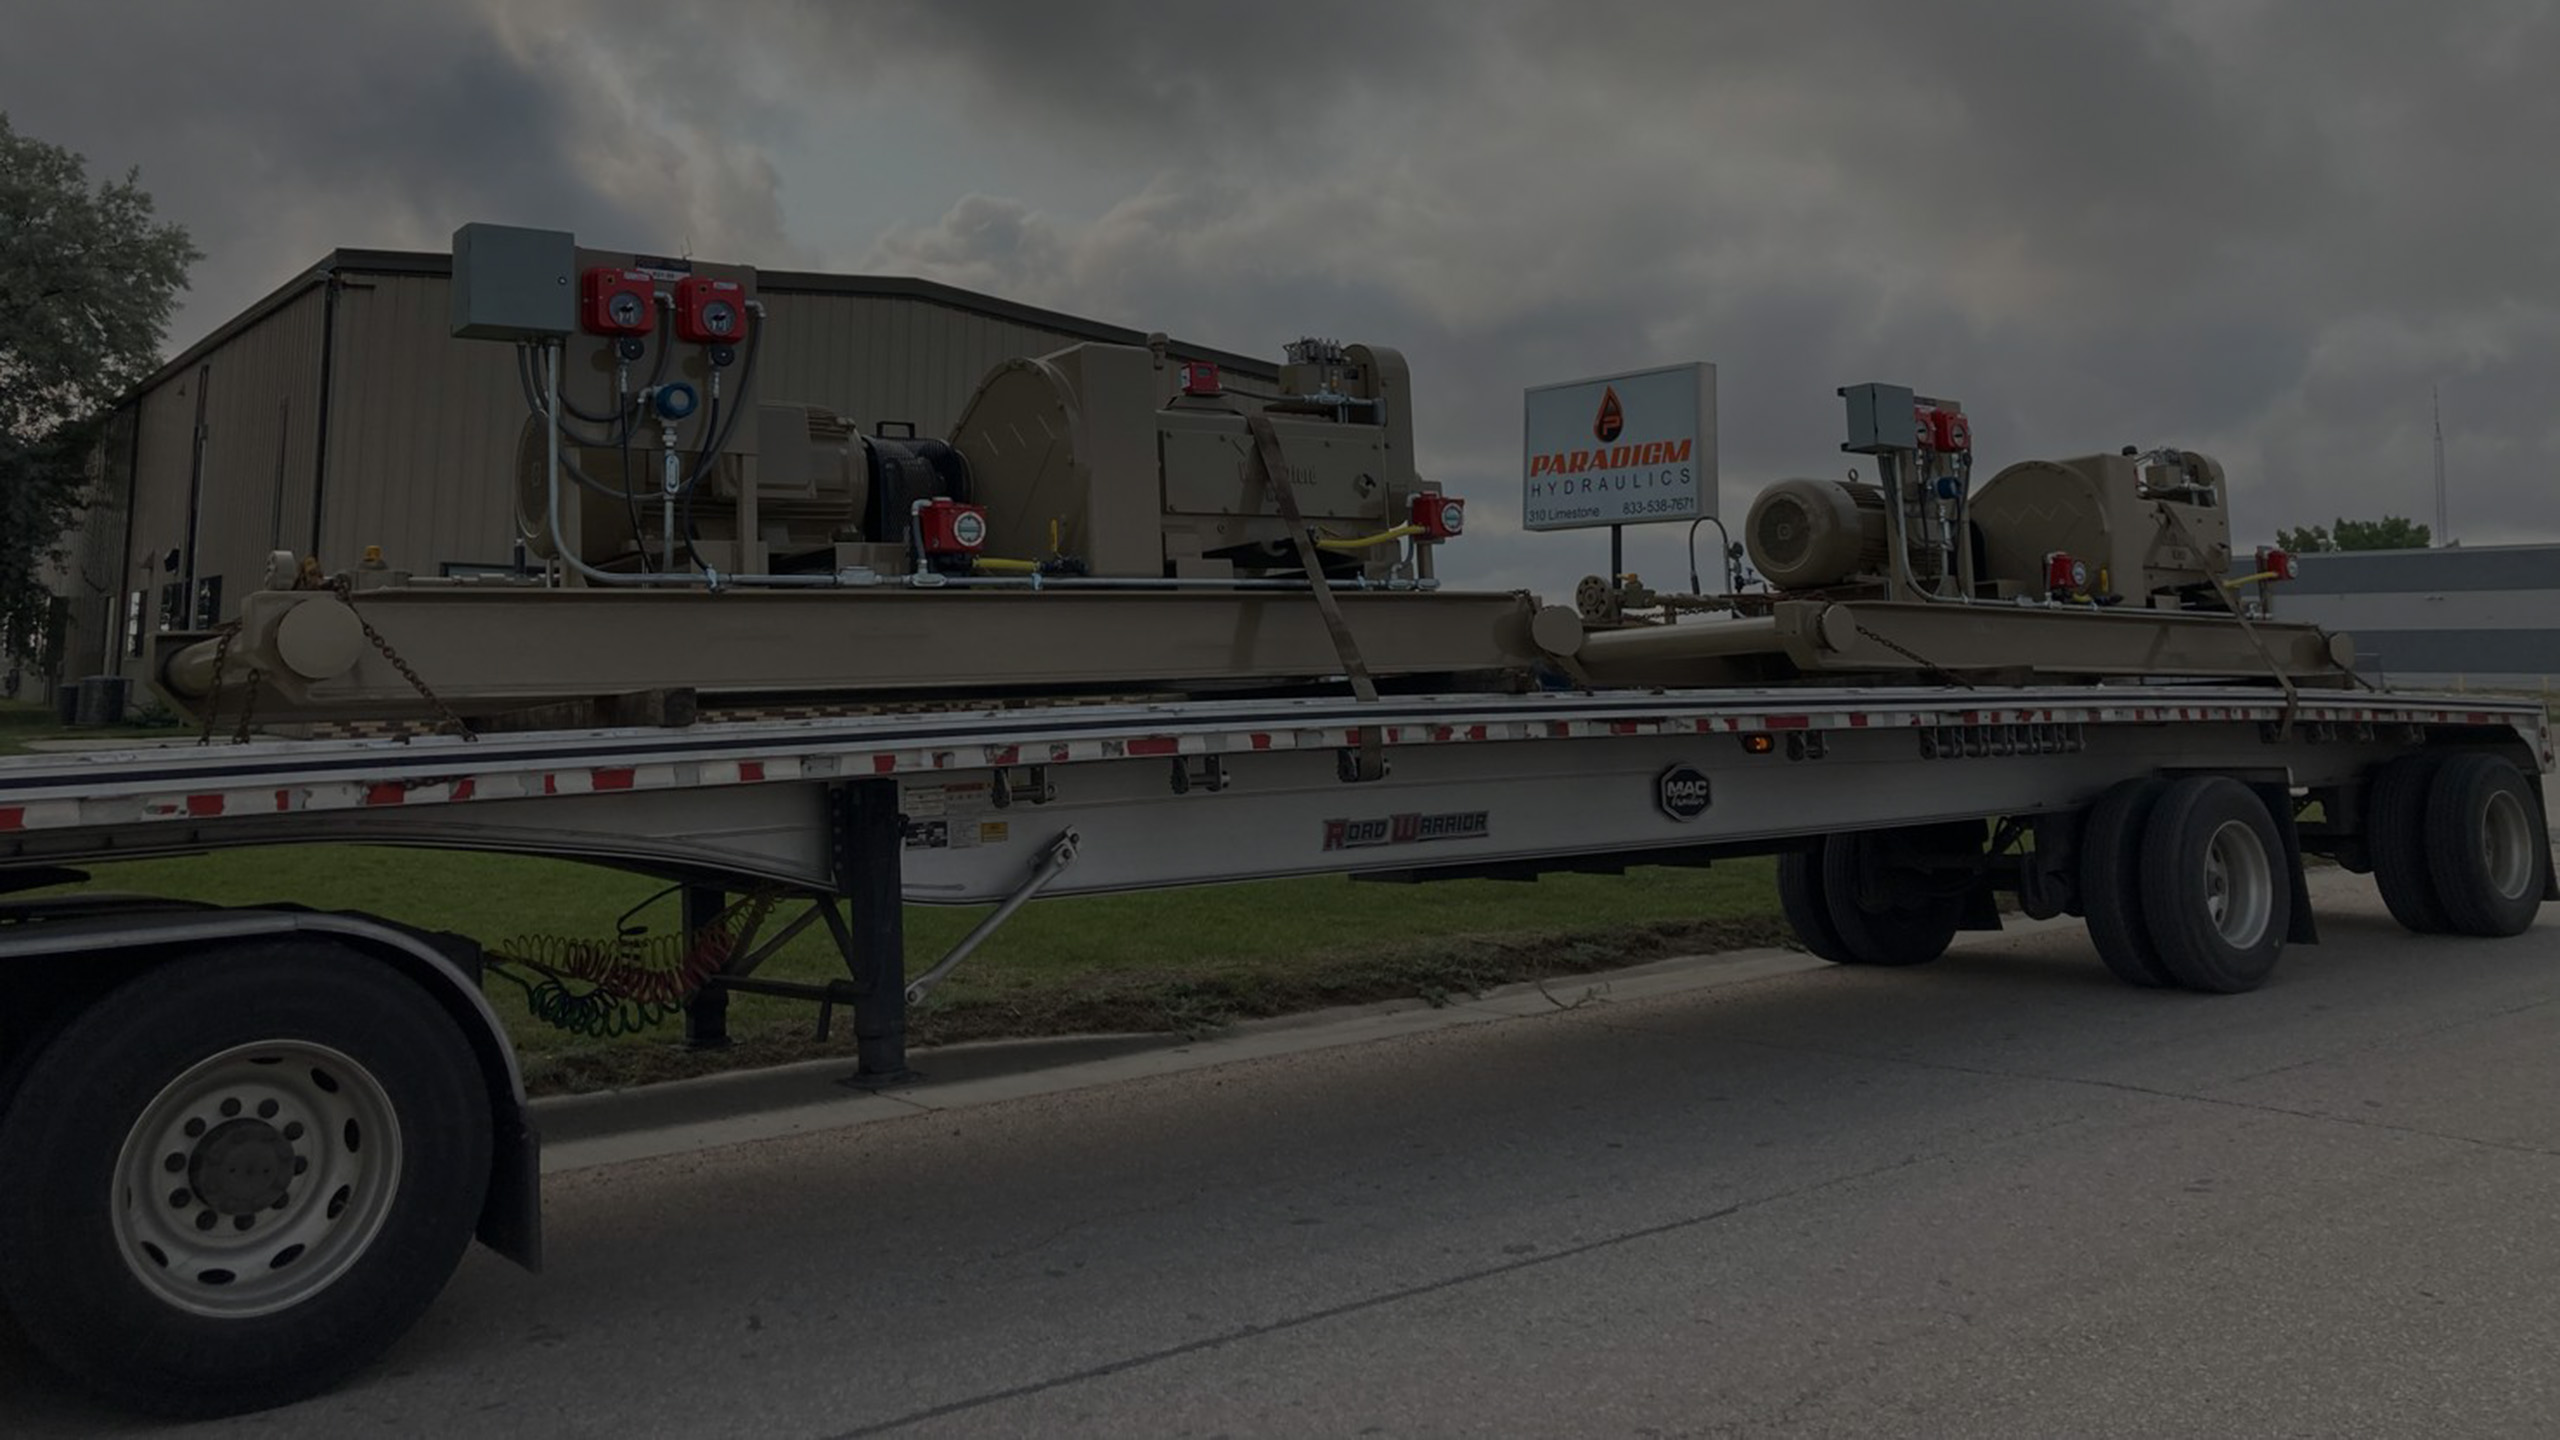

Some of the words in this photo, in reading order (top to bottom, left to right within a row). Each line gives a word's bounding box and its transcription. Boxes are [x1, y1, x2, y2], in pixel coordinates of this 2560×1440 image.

[1530, 439, 1692, 477] PARADIGM
[1531, 468, 1691, 497] HYDRAULICS
[1528, 509, 1546, 522] 310
[1549, 507, 1600, 521] Limestone
[1622, 497, 1694, 515] 833-538-7671
[1667, 780, 1707, 798] MAC
[1322, 818, 1388, 851] ROAD
[1389, 811, 1489, 844] WARRIOR
